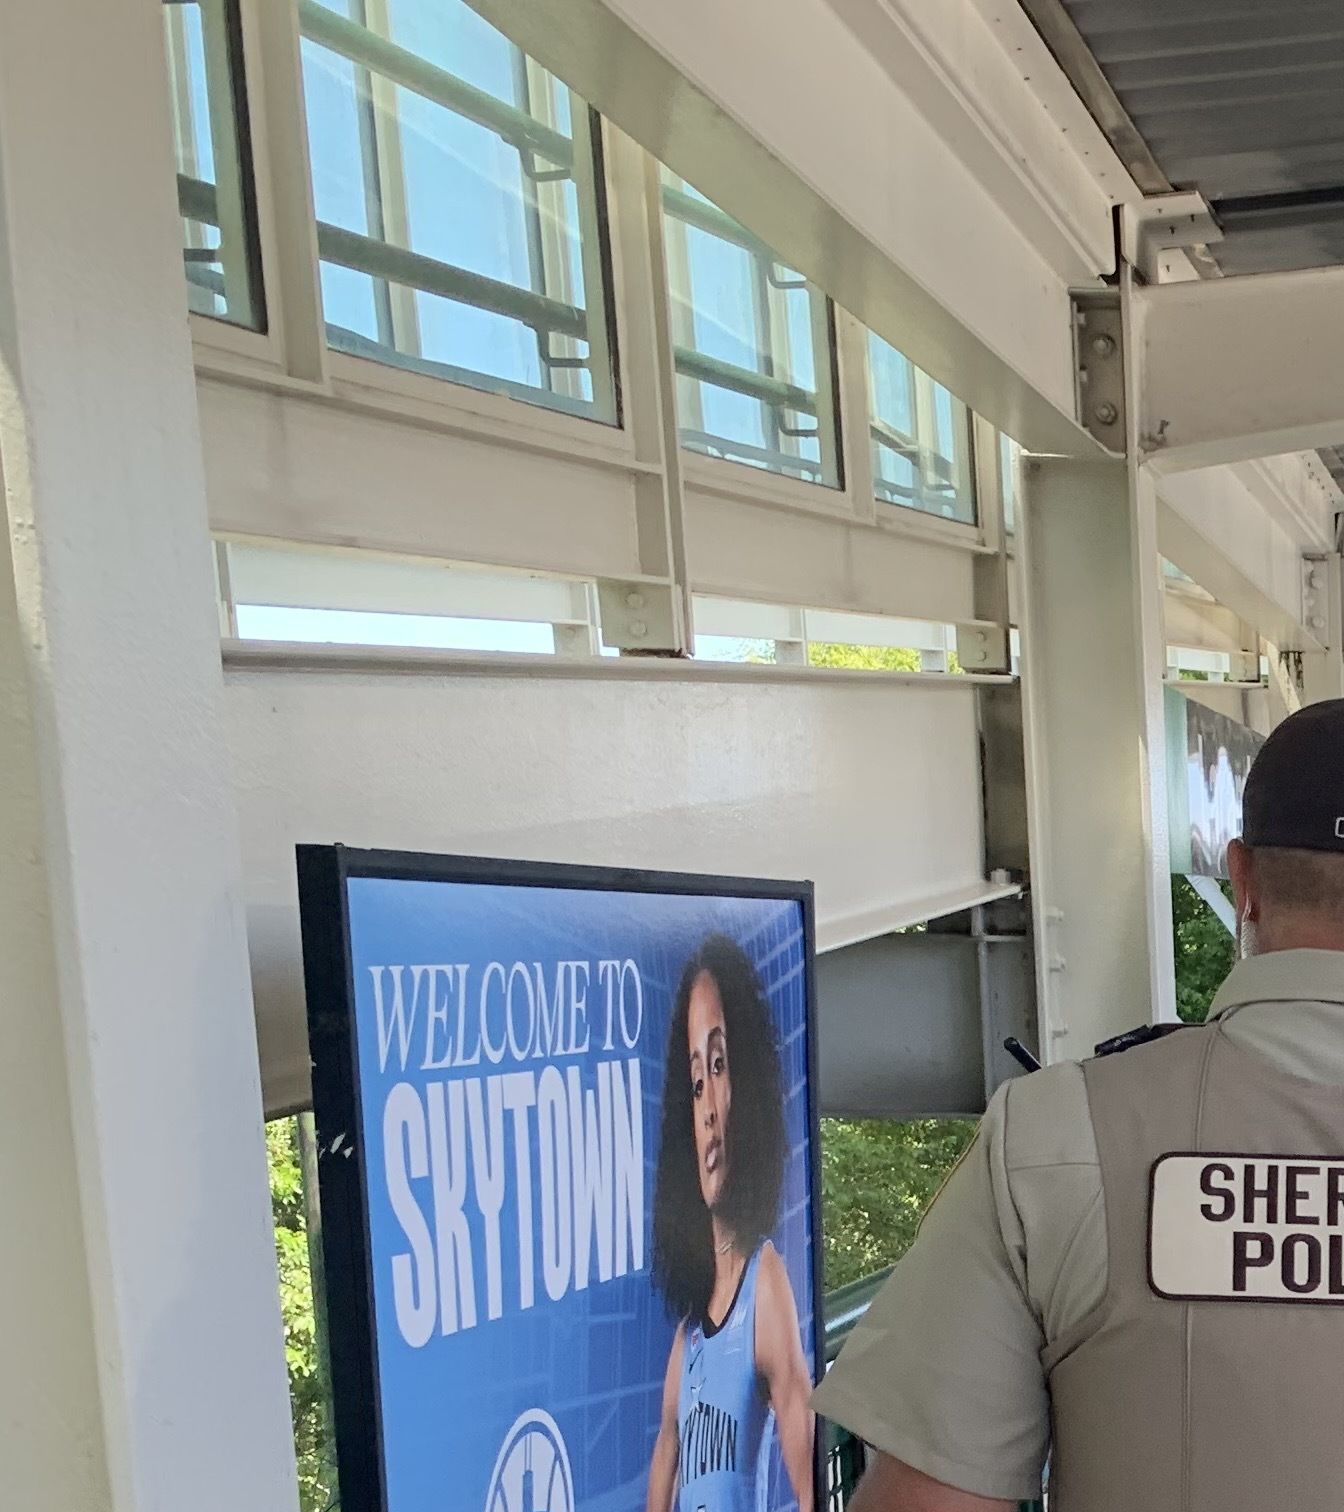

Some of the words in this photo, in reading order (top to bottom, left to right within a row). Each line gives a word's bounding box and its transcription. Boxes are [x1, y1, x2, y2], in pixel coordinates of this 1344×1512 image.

[368, 961, 589, 1074] WELCOME
[598, 958, 642, 1050] TO
[383, 1057, 644, 1349] SKYTOWN
